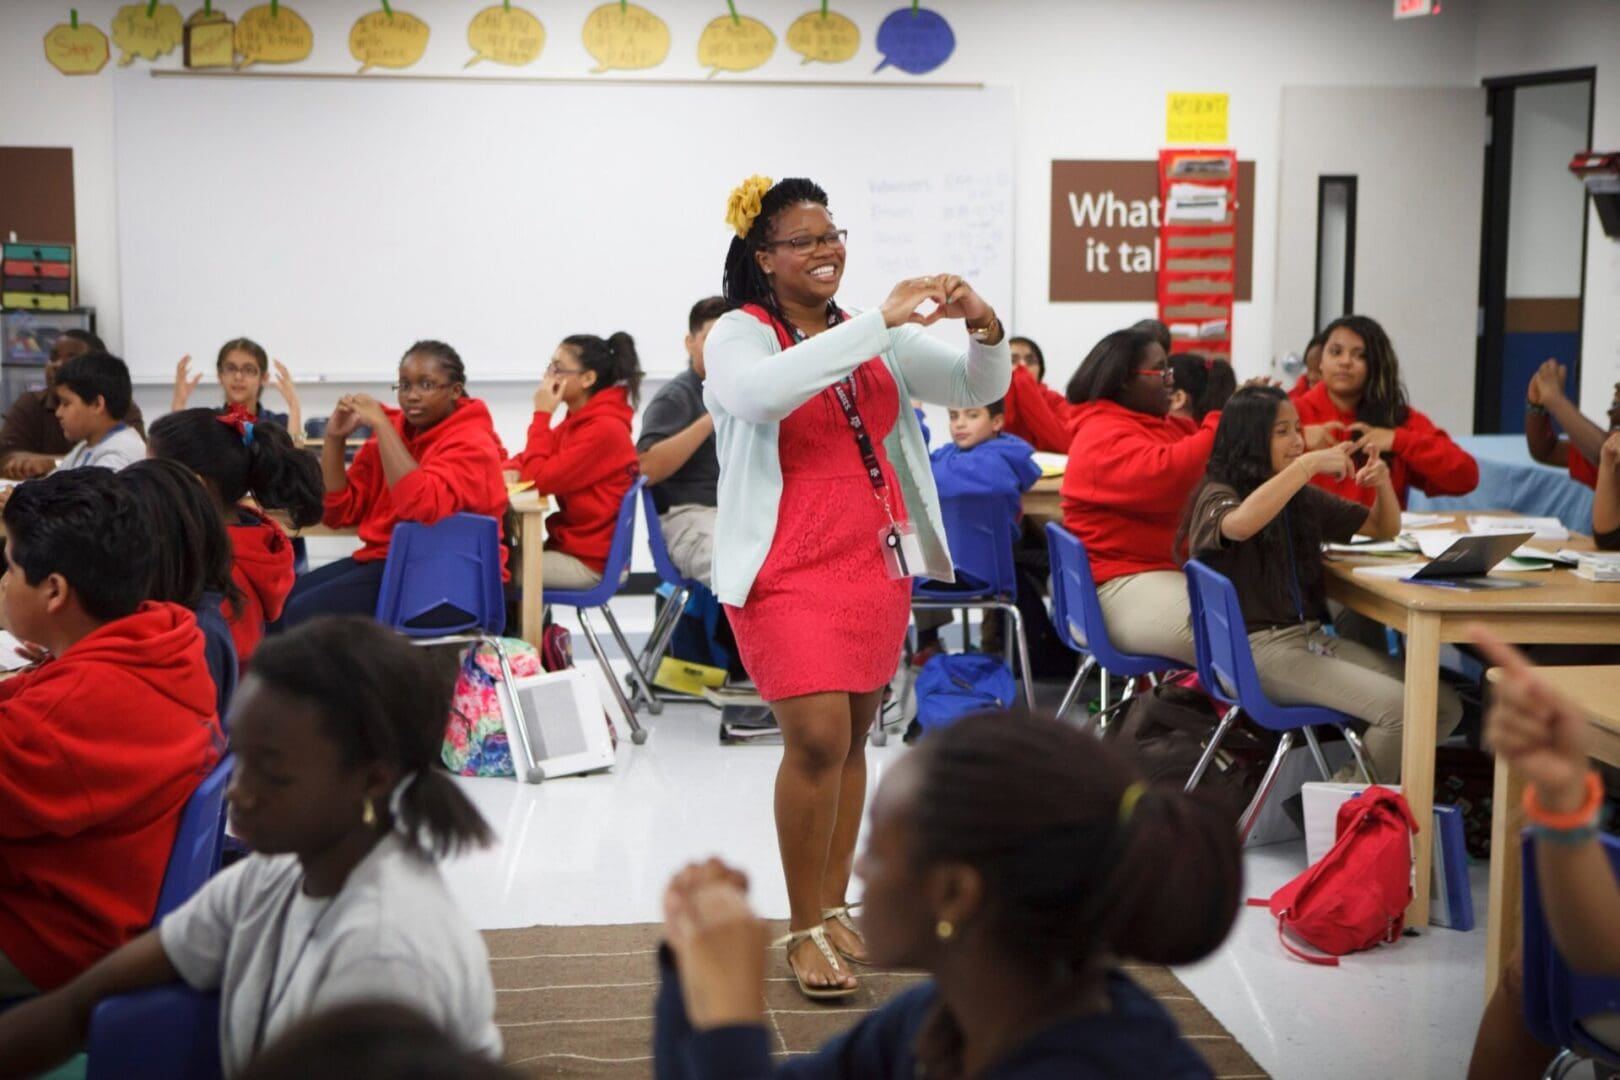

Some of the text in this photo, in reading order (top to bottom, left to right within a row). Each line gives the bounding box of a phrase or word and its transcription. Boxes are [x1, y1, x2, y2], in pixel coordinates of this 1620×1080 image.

[53, 35, 95, 62] Stop
[1068, 190, 1161, 228] What
[1085, 236, 1110, 273] it
